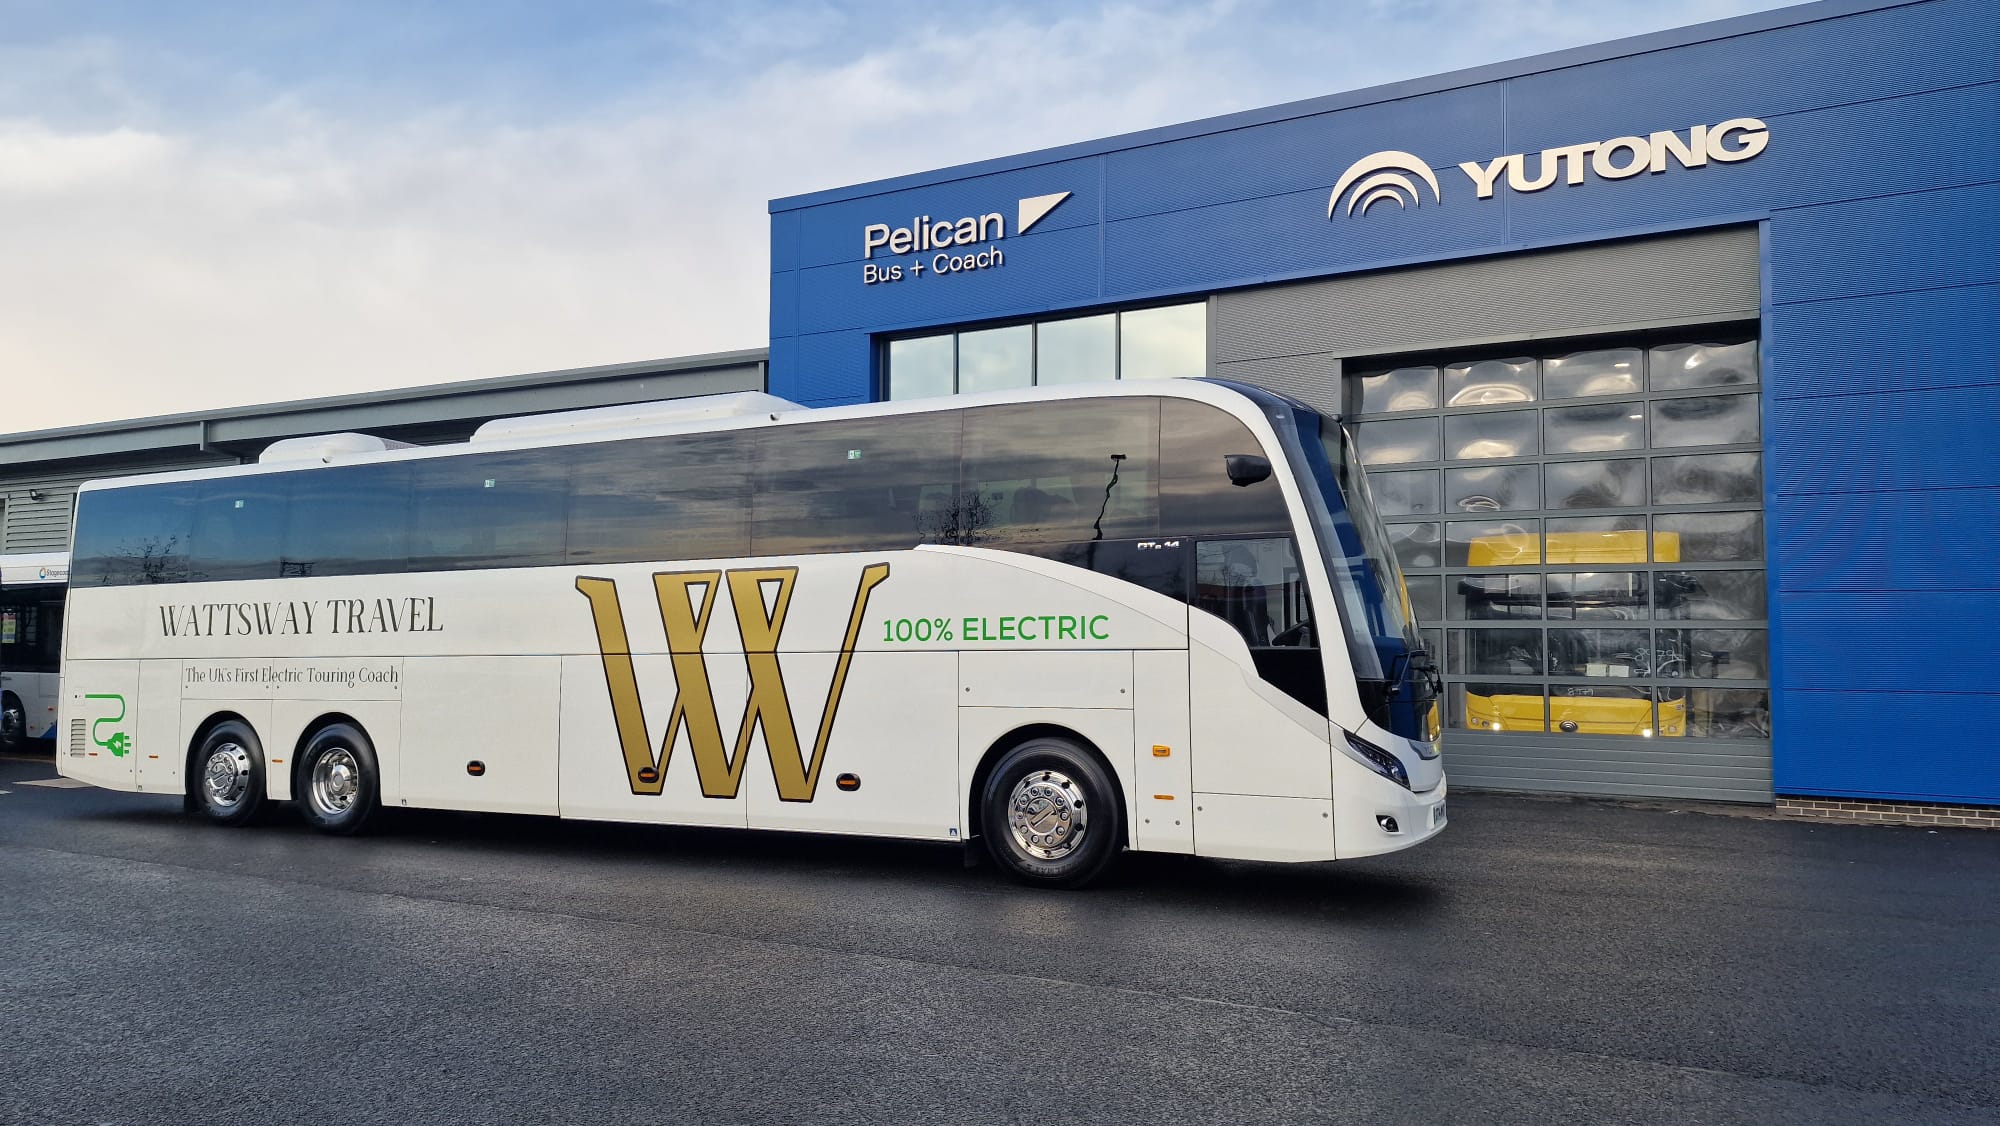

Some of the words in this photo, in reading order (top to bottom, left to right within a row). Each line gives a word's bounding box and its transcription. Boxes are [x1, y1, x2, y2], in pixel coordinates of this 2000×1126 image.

[1458, 117, 1769, 198] YUTONG
[864, 212, 1005, 259] Pelican
[863, 263, 902, 284] Bus
[932, 245, 1004, 275] Coach
[159, 601, 318, 637] WATTSWAY
[326, 596, 444, 634] TRAVEL
[883, 617, 954, 642] 100%
[962, 614, 1110, 641] ELECTRIC
[185, 666, 206, 682] The
[209, 667, 232, 682] UK's
[235, 667, 258, 682] First
[262, 665, 303, 682] Electric
[307, 667, 355, 688] Touring
[358, 665, 399, 682] Coach
